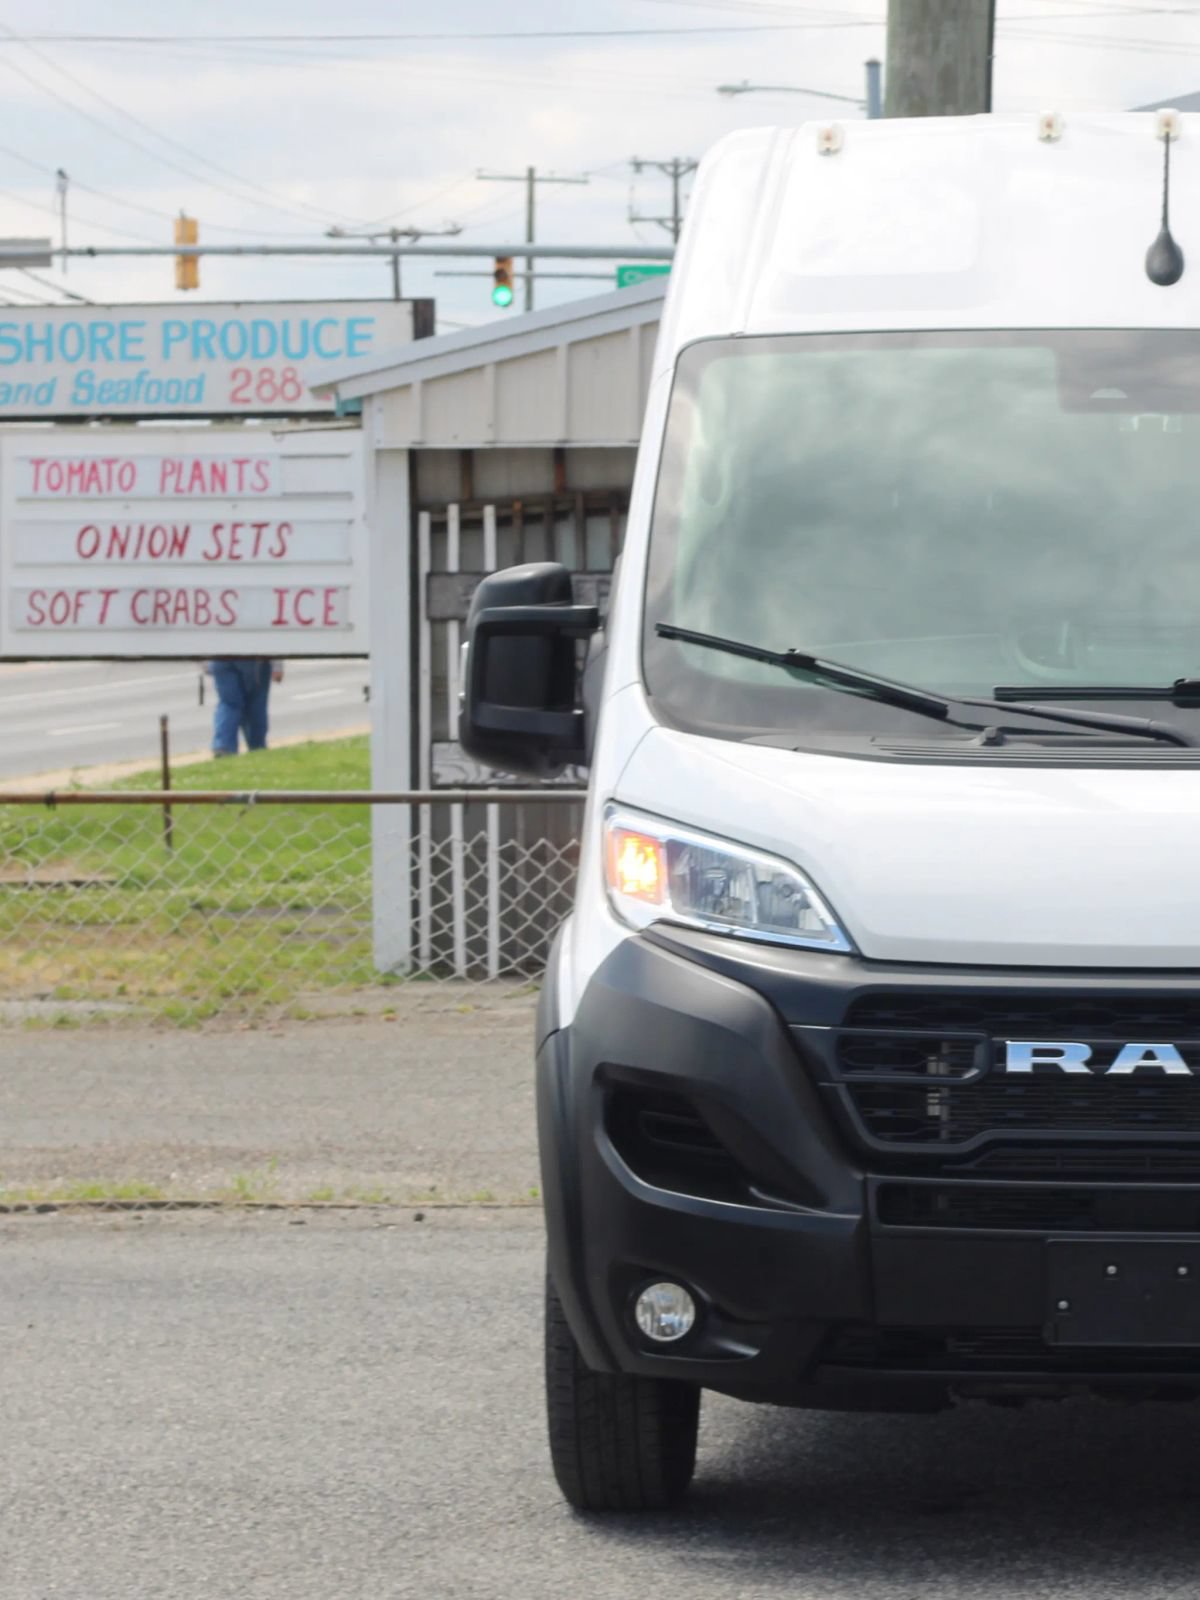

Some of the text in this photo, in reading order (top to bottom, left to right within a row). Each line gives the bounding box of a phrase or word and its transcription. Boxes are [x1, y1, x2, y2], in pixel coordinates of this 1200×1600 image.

[0, 317, 375, 365] SHORE PRODUCE
[0, 376, 57, 406] and
[70, 368, 206, 406] Seafood
[29, 458, 271, 493] TOMATO PLANTS
[76, 522, 293, 561] ONION SETS
[26, 588, 340, 627] SOFT CRABS ICE
